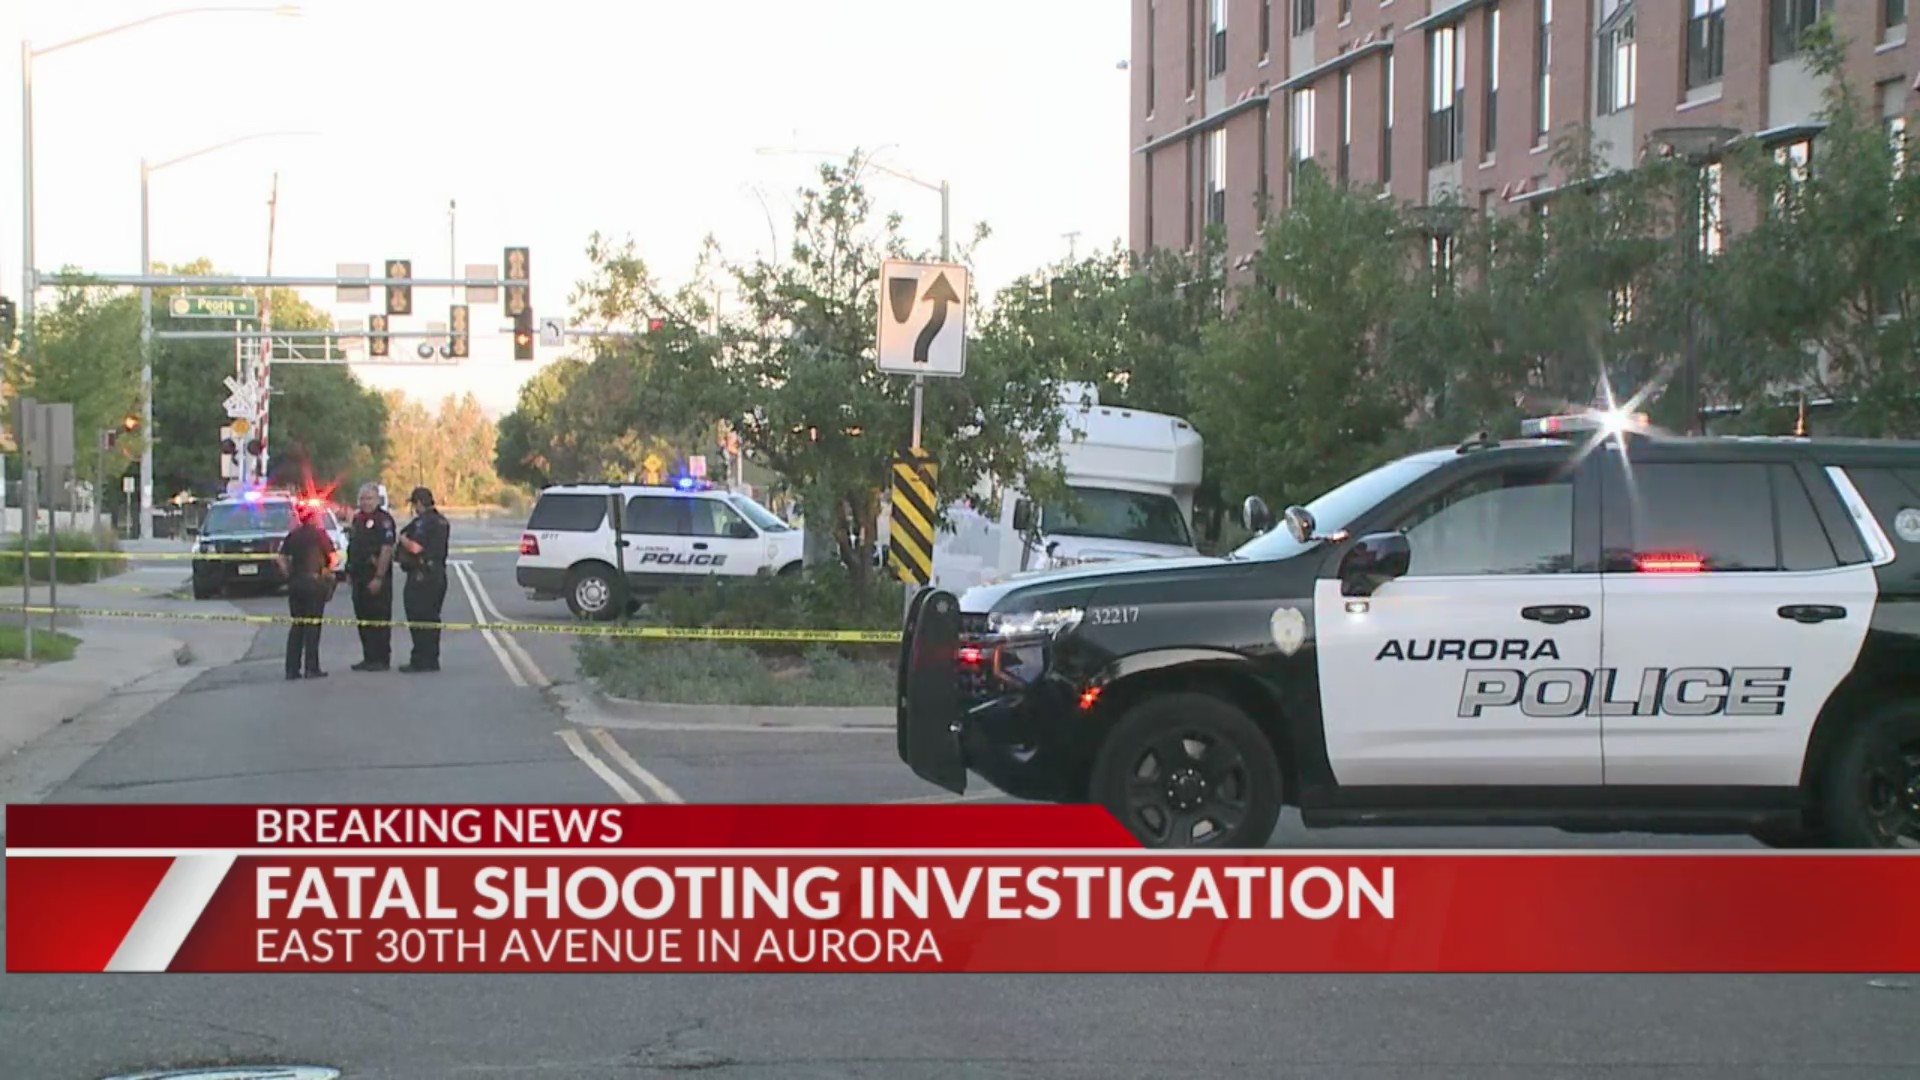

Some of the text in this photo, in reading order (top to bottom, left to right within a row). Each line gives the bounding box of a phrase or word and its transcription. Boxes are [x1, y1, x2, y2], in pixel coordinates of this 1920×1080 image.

[198, 299, 235, 314] Peoria
[641, 553, 728, 566] POLICE
[1092, 607, 1139, 625] 32217
[1375, 639, 1561, 661] AURORA
[1457, 667, 1792, 718] POLICE
